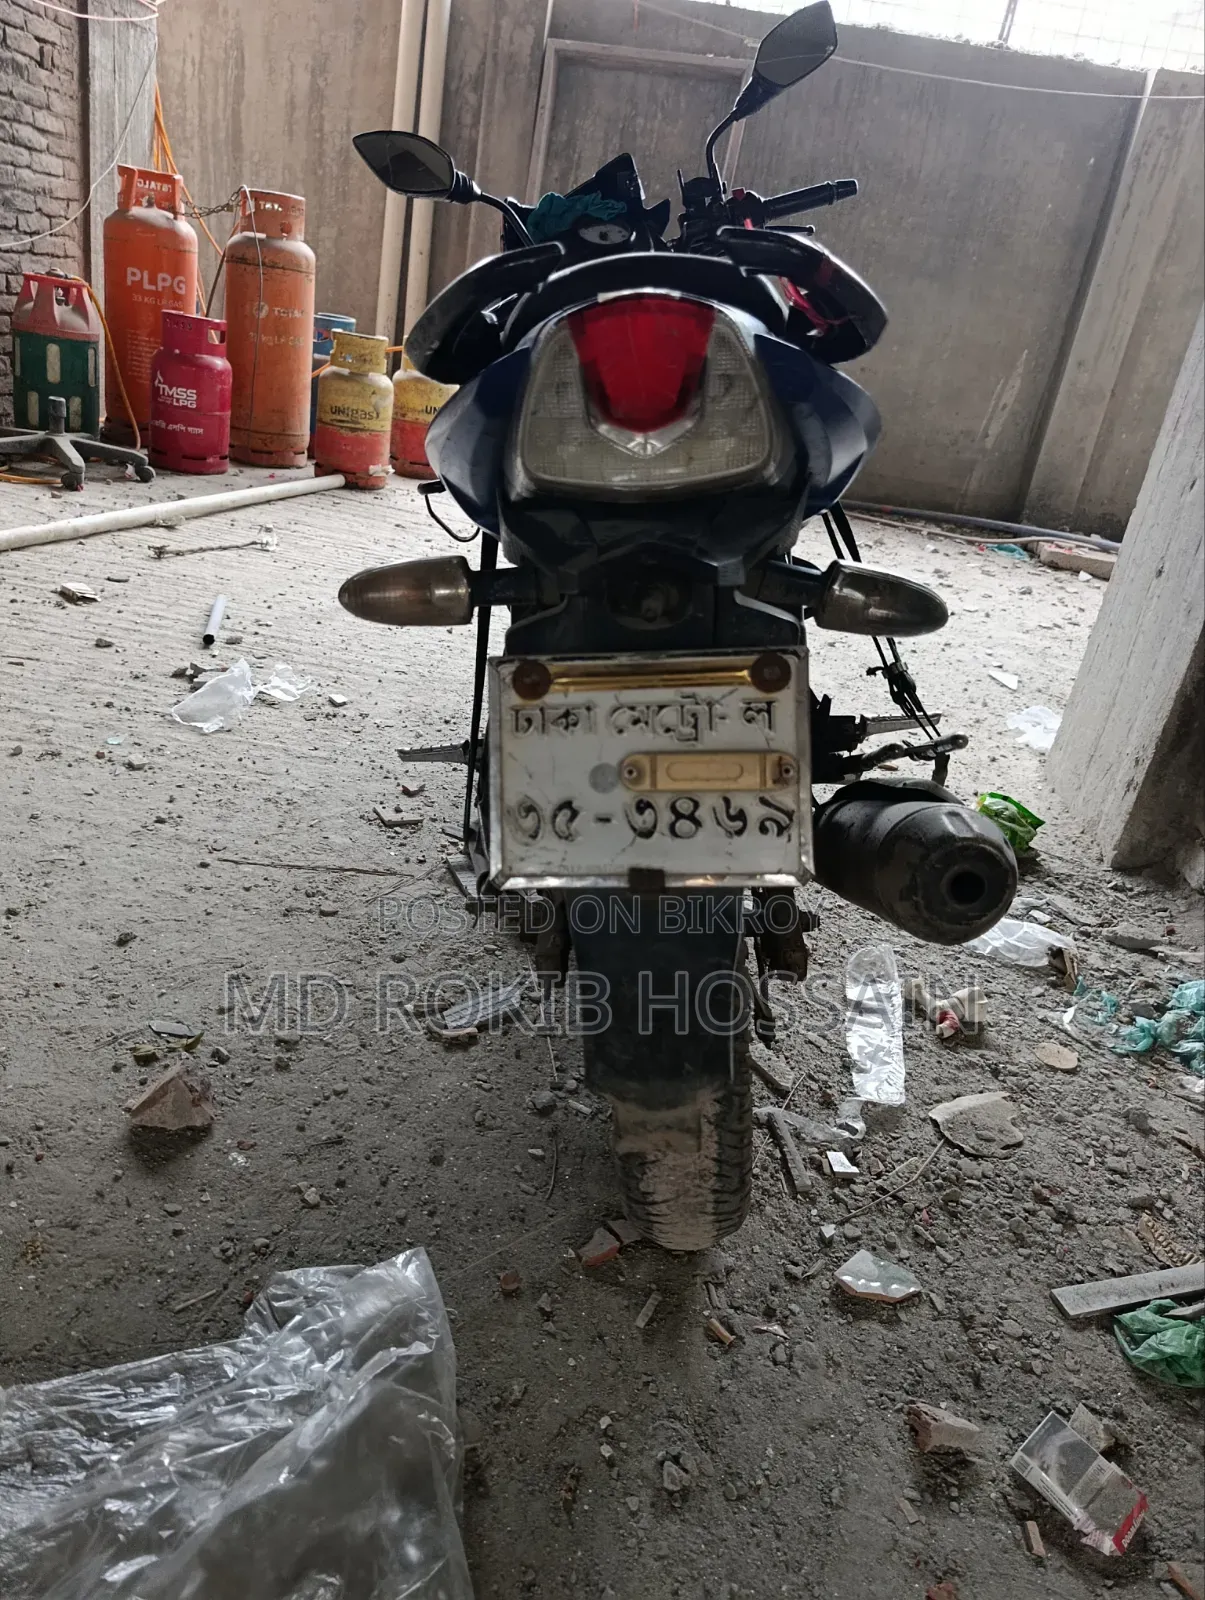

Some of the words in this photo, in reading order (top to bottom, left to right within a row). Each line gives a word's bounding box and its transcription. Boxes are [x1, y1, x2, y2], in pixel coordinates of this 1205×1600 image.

[126, 267, 186, 295] PLPG
[144, 296, 156, 305] KG
[158, 383, 197, 401] TMSS
[173, 398, 197, 409] LPG
[509, 703, 597, 736] ঢাকা
